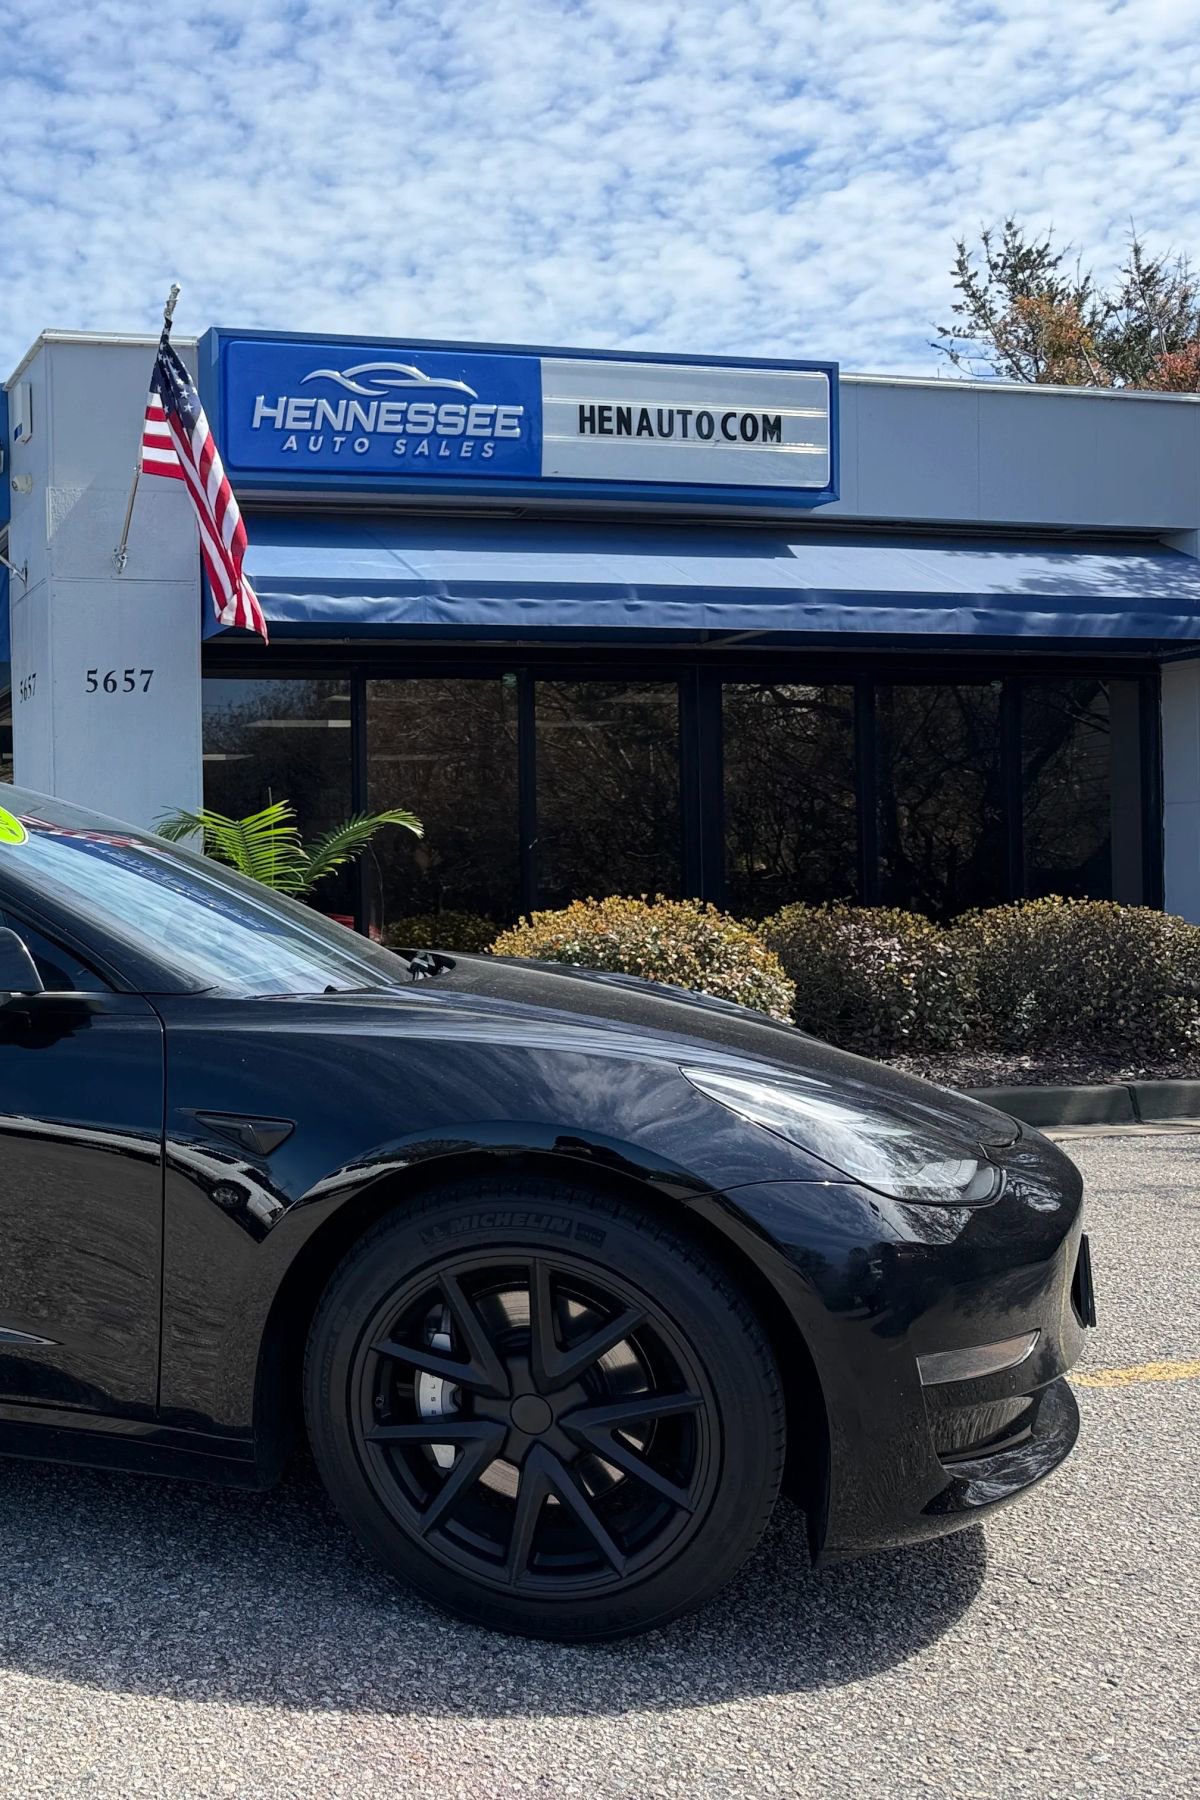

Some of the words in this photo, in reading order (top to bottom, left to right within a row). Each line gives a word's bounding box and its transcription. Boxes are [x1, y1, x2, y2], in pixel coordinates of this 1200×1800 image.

[252, 395, 524, 438] HENNESSEE
[282, 434, 370, 453] AUTO
[393, 438, 495, 458] SALES
[19, 672, 37, 704] 5657
[85, 668, 154, 694] 5657
[451, 1212, 572, 1234] MICHELIN
